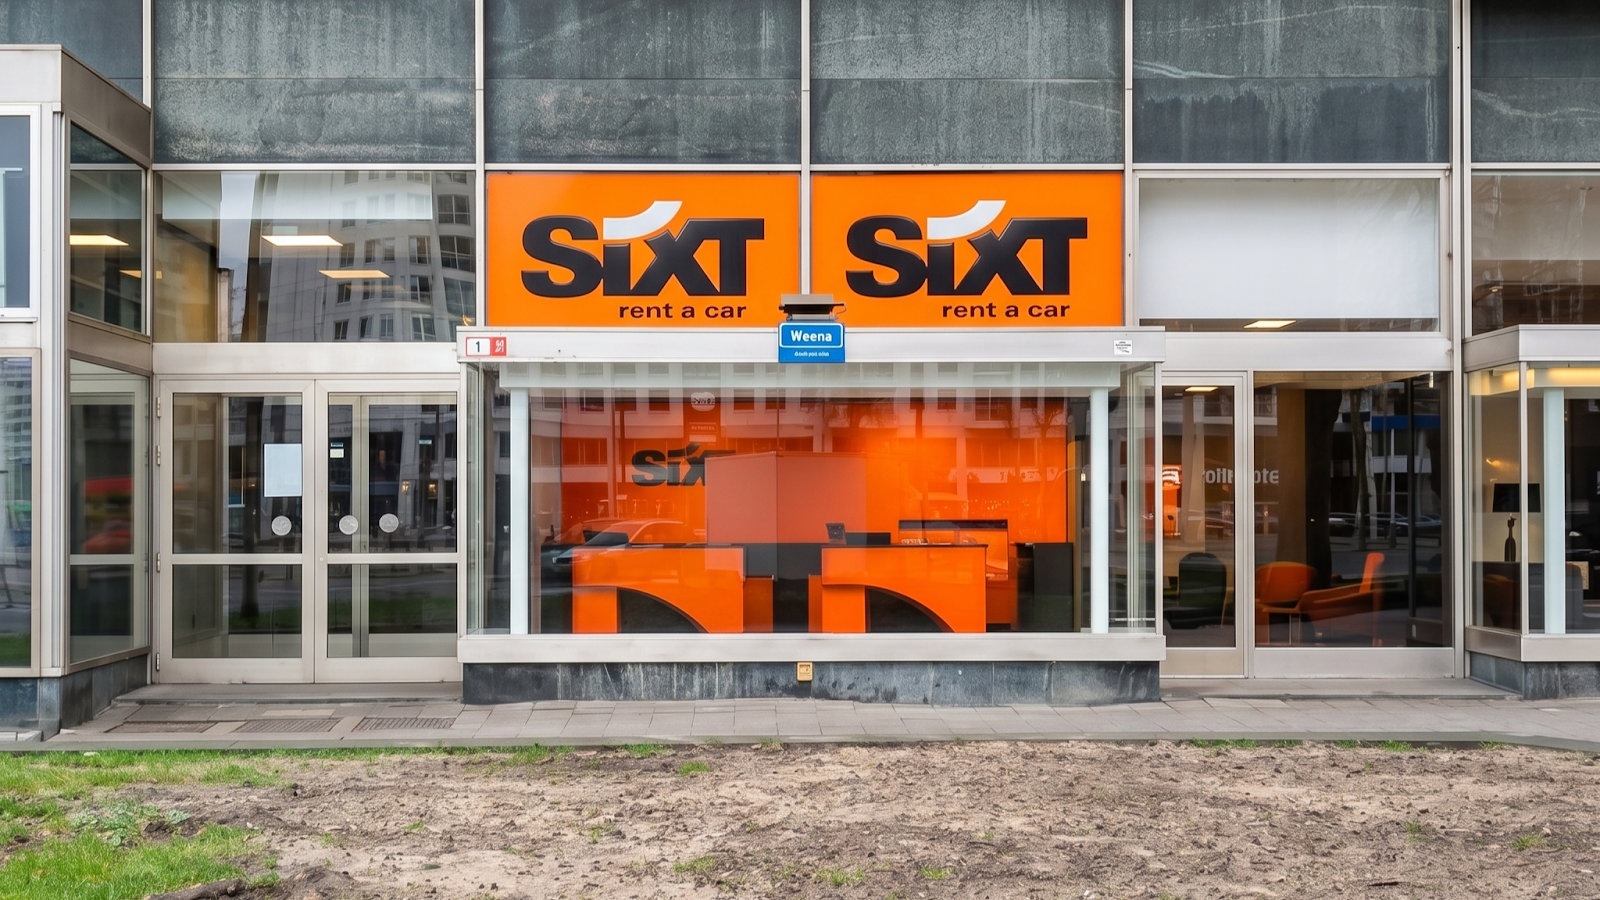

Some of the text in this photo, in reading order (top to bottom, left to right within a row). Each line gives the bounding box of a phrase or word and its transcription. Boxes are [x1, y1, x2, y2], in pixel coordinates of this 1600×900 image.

[619, 303, 747, 319] rent a car
[942, 302, 1070, 318] rent a car
[790, 329, 833, 342] Weena
[475, 340, 481, 353] 1
[631, 443, 736, 487] SIX
